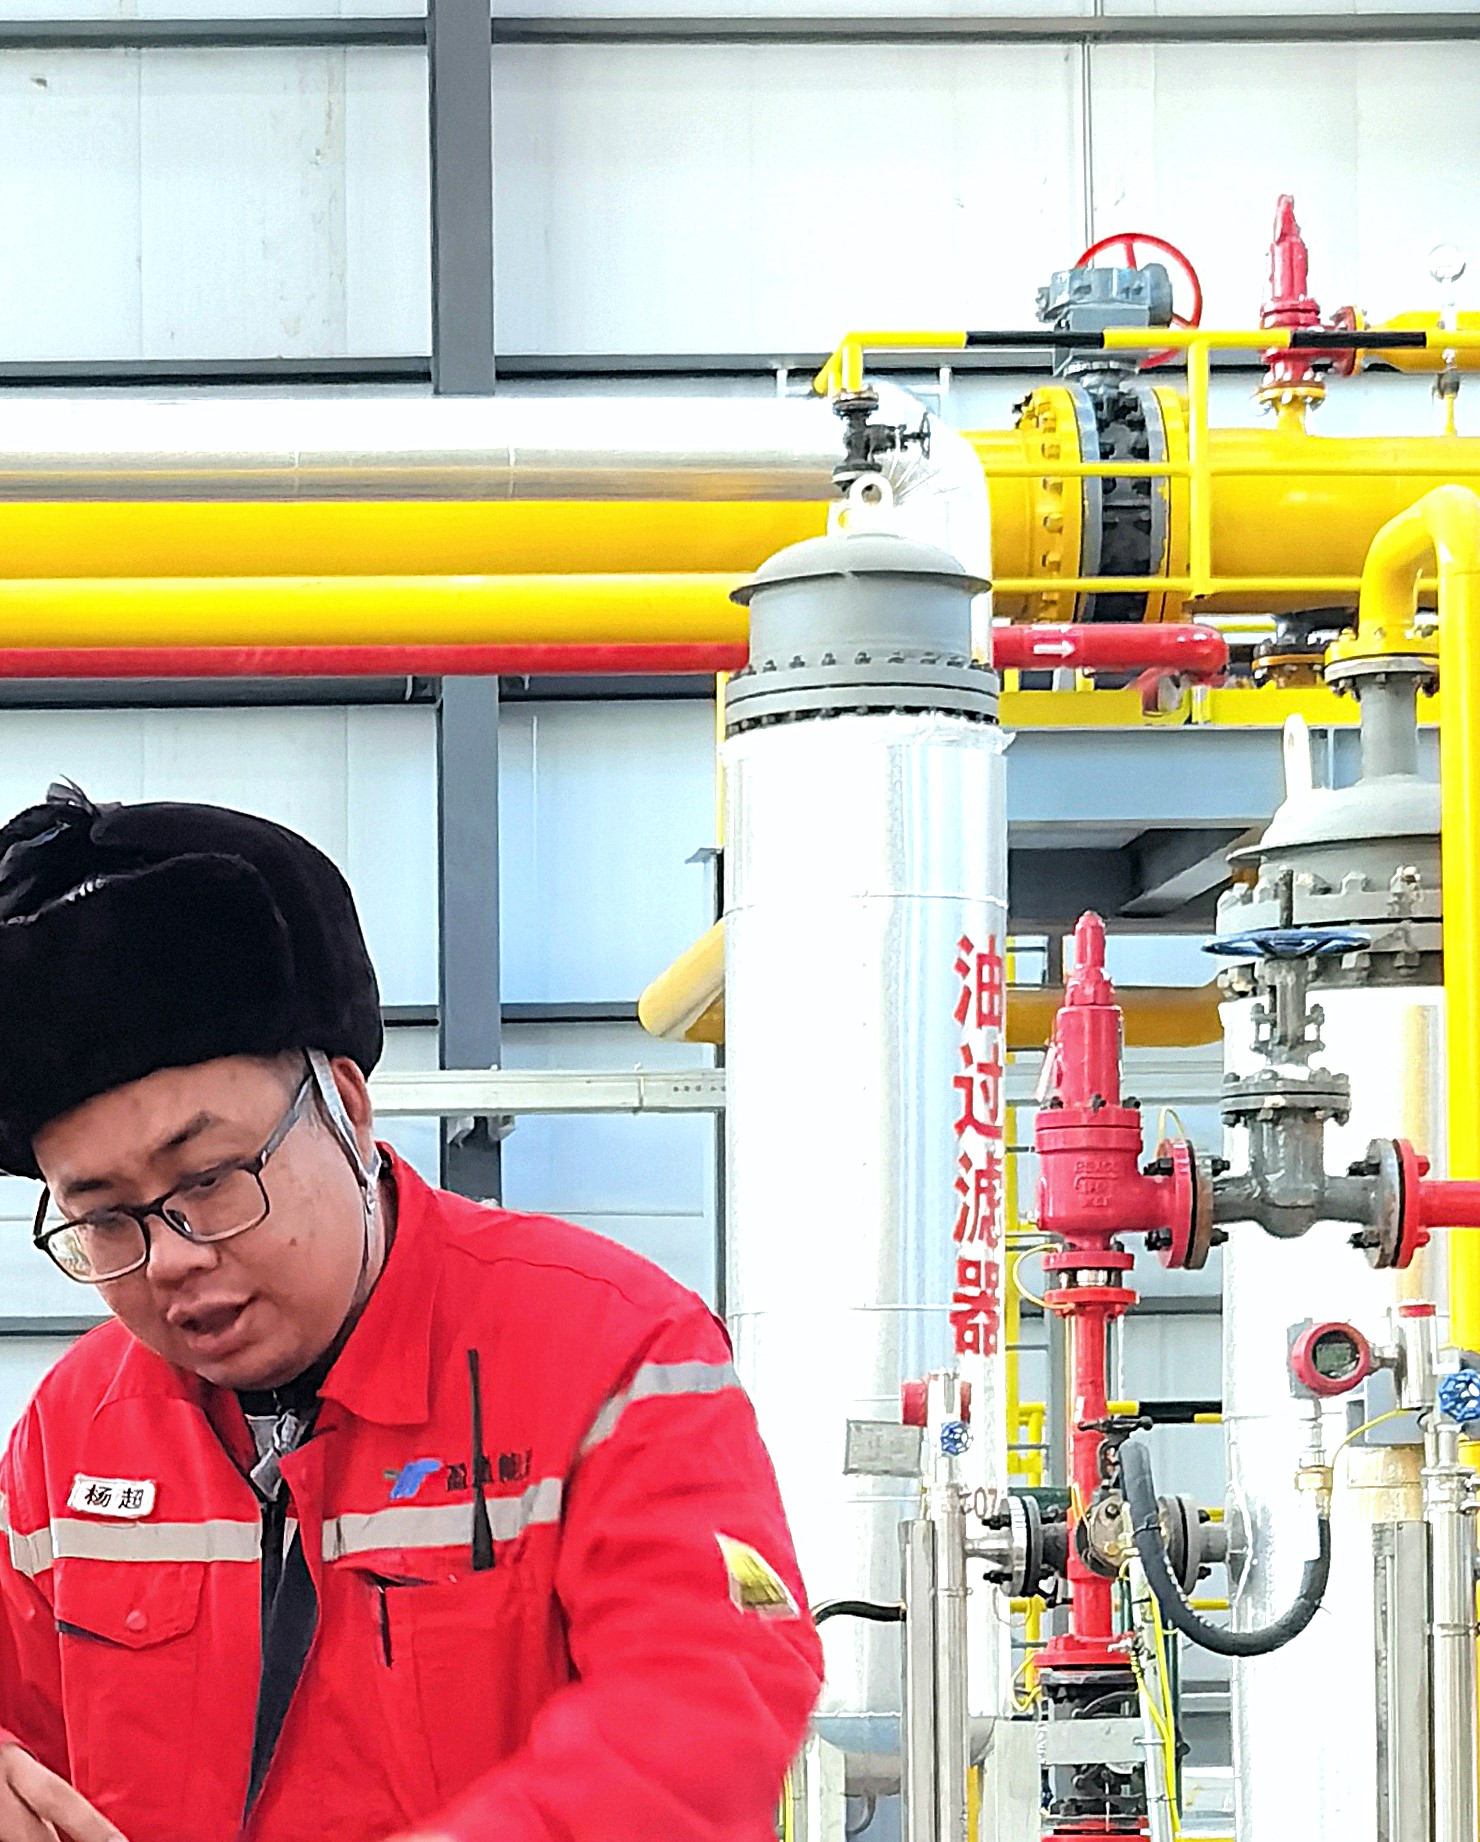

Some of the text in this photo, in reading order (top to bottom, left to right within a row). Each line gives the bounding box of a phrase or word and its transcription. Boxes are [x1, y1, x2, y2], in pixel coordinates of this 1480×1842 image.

[951, 935, 1003, 1356] 油过滤器
[84, 1484, 145, 1510] 杨超
